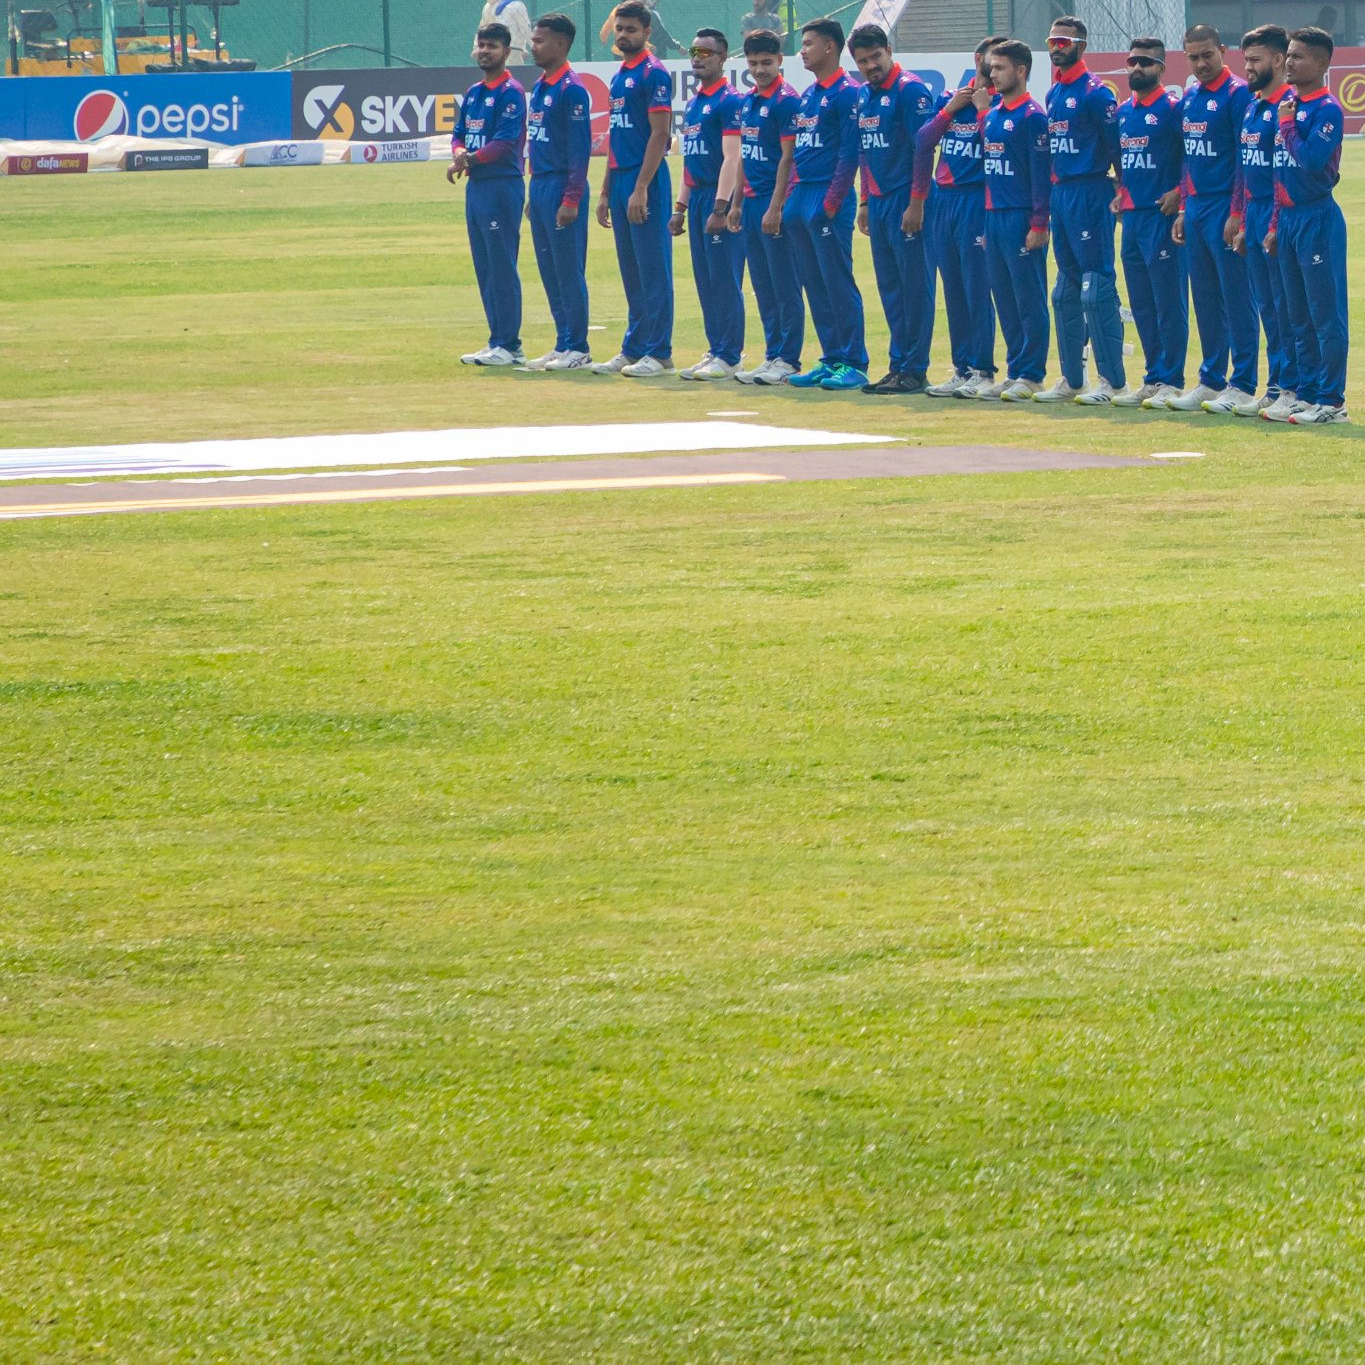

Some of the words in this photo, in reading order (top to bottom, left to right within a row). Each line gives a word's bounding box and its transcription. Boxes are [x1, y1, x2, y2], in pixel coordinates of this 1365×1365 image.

[137, 95, 239, 138] pepsi
[270, 145, 297, 159] ACC
[382, 142, 418, 152] TURKISH
[174, 154, 201, 162] GROUP
[382, 151, 418, 161] AIRLINES
